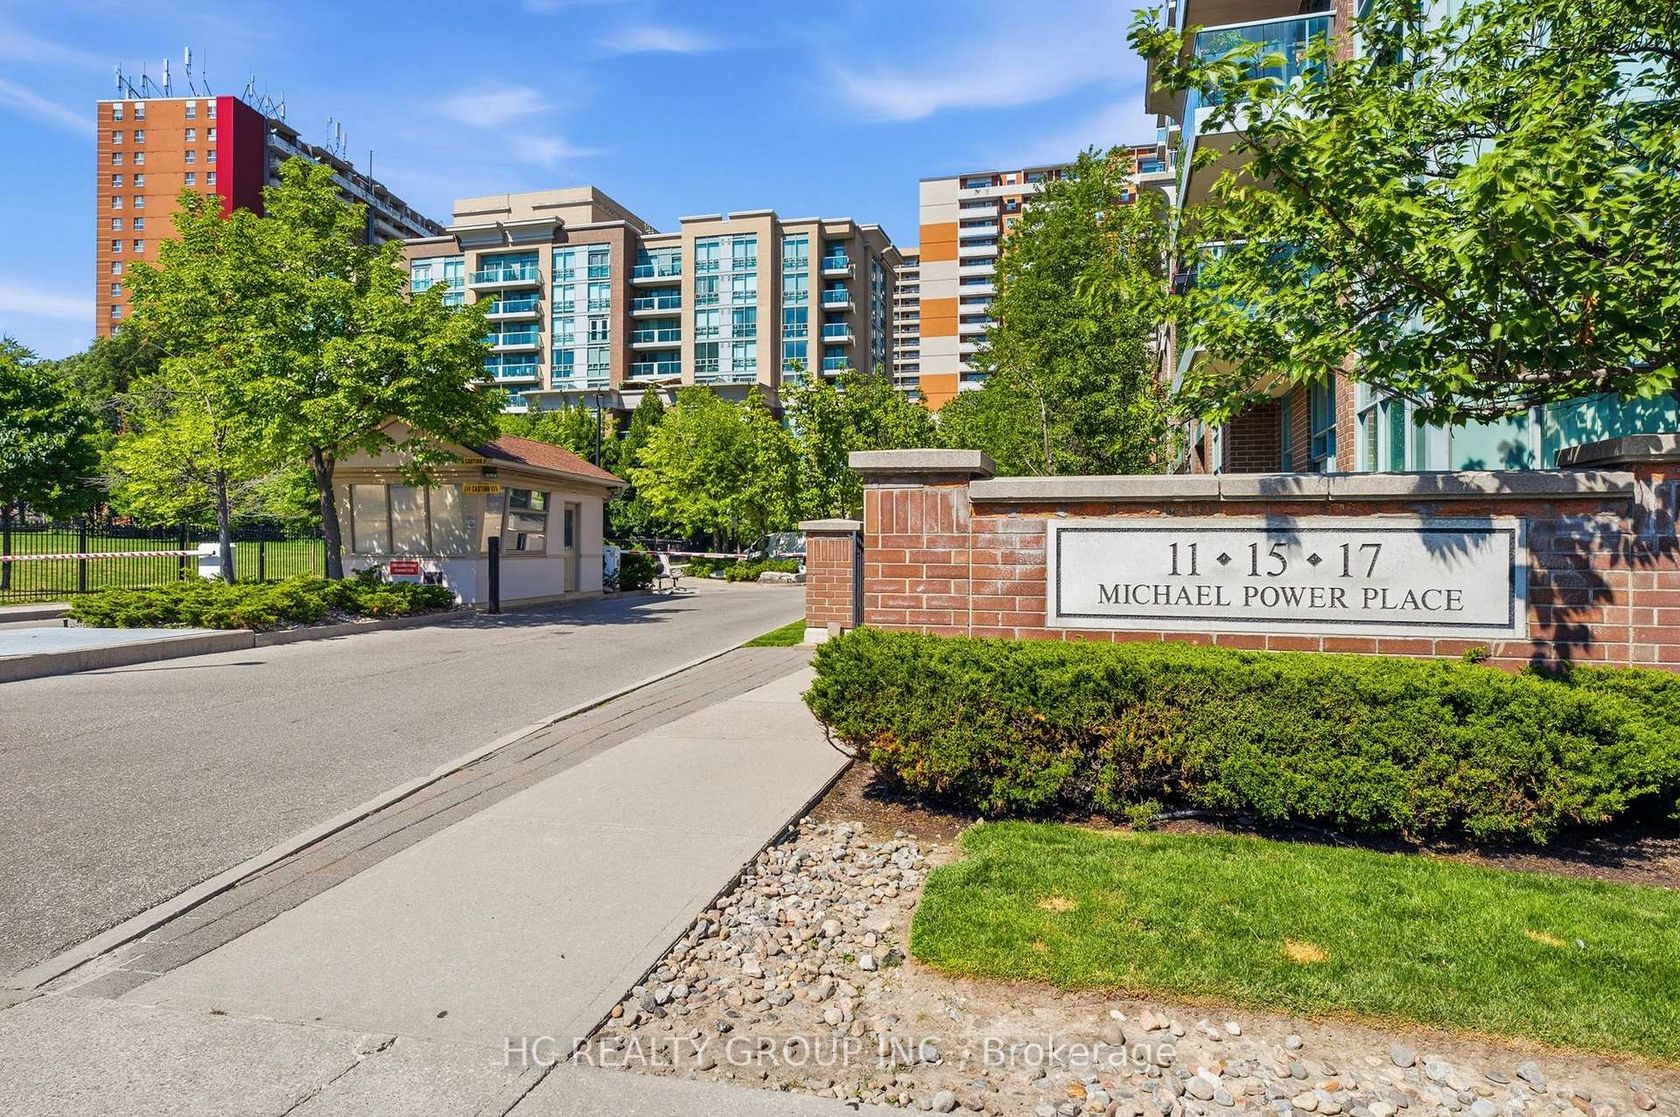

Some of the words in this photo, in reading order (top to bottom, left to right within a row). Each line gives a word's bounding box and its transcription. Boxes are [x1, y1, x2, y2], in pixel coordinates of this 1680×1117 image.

[1168, 542, 1202, 576] 11
[1247, 542, 1288, 577] 15
[1338, 543, 1383, 578] 17
[1098, 583, 1231, 606] MICHAEL
[1242, 586, 1349, 609] POWER
[1361, 588, 1464, 611] PLACE
